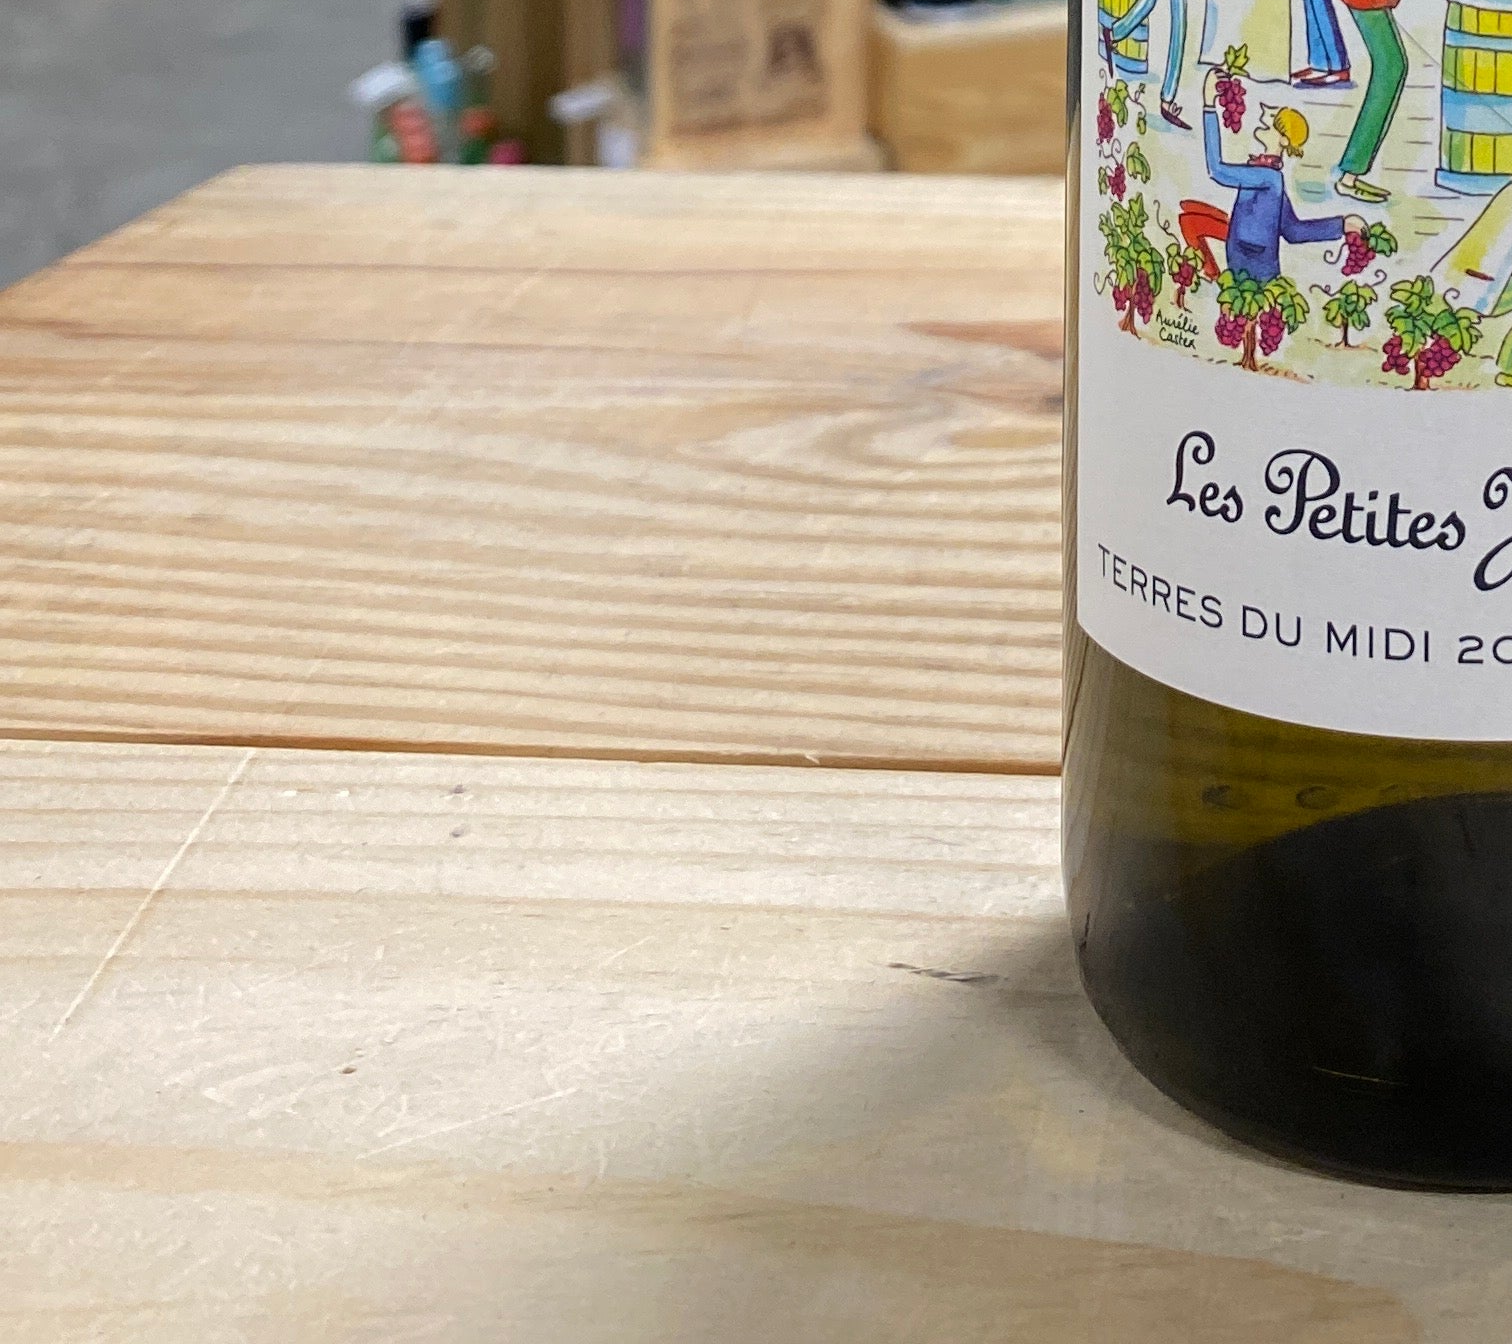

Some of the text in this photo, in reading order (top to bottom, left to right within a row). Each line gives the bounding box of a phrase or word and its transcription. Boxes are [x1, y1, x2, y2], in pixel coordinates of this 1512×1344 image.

[1166, 430, 1244, 524] Les
[1264, 448, 1466, 551] Petites
[1097, 542, 1224, 629] TERRES
[1242, 604, 1302, 648] DU
[1326, 620, 1430, 663] MIDI
